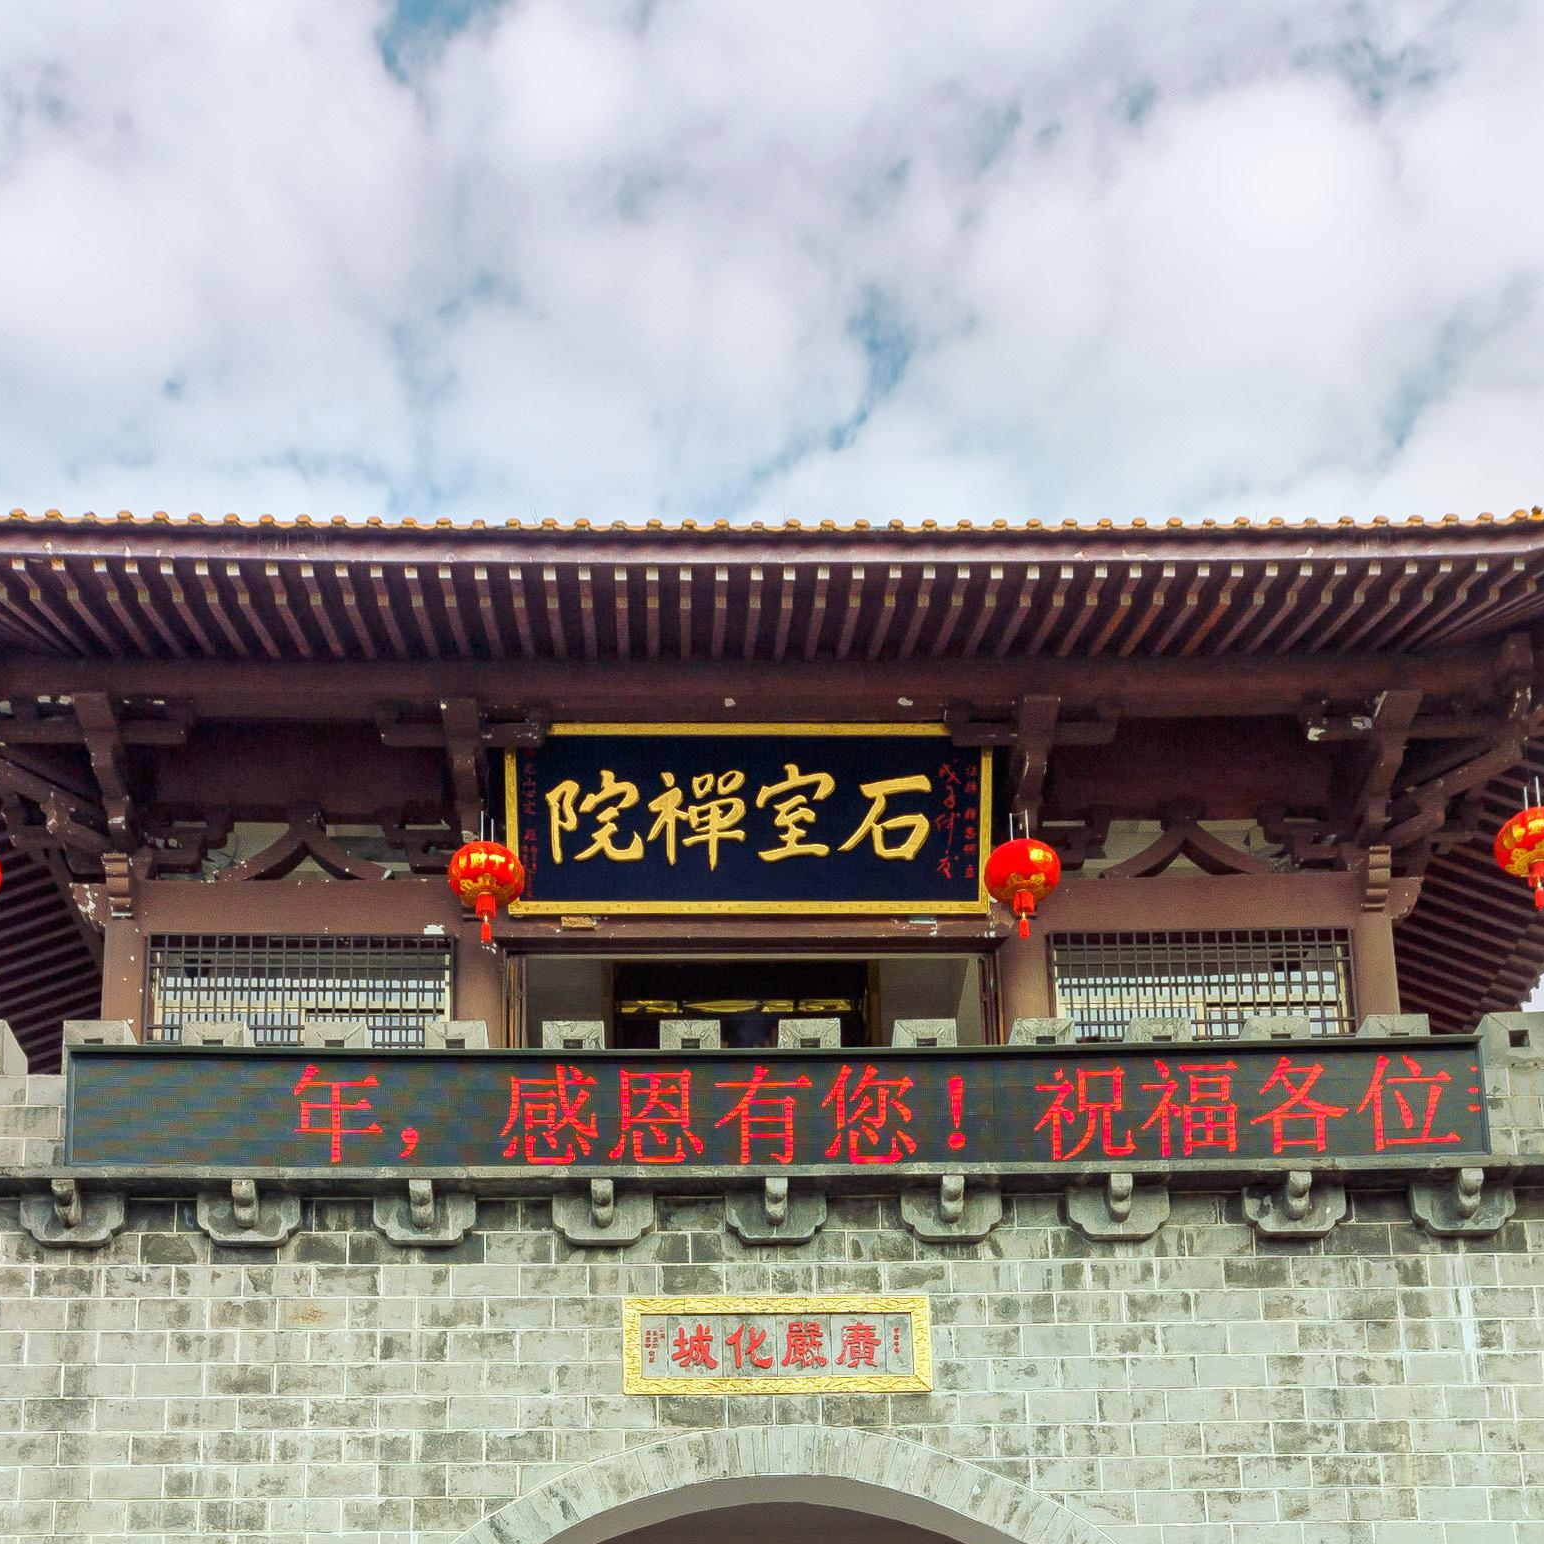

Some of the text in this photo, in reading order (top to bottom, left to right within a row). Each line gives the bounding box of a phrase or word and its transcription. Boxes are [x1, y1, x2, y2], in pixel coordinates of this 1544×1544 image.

[293, 1056, 1481, 1168] 年，感恩有您！祝福各位
